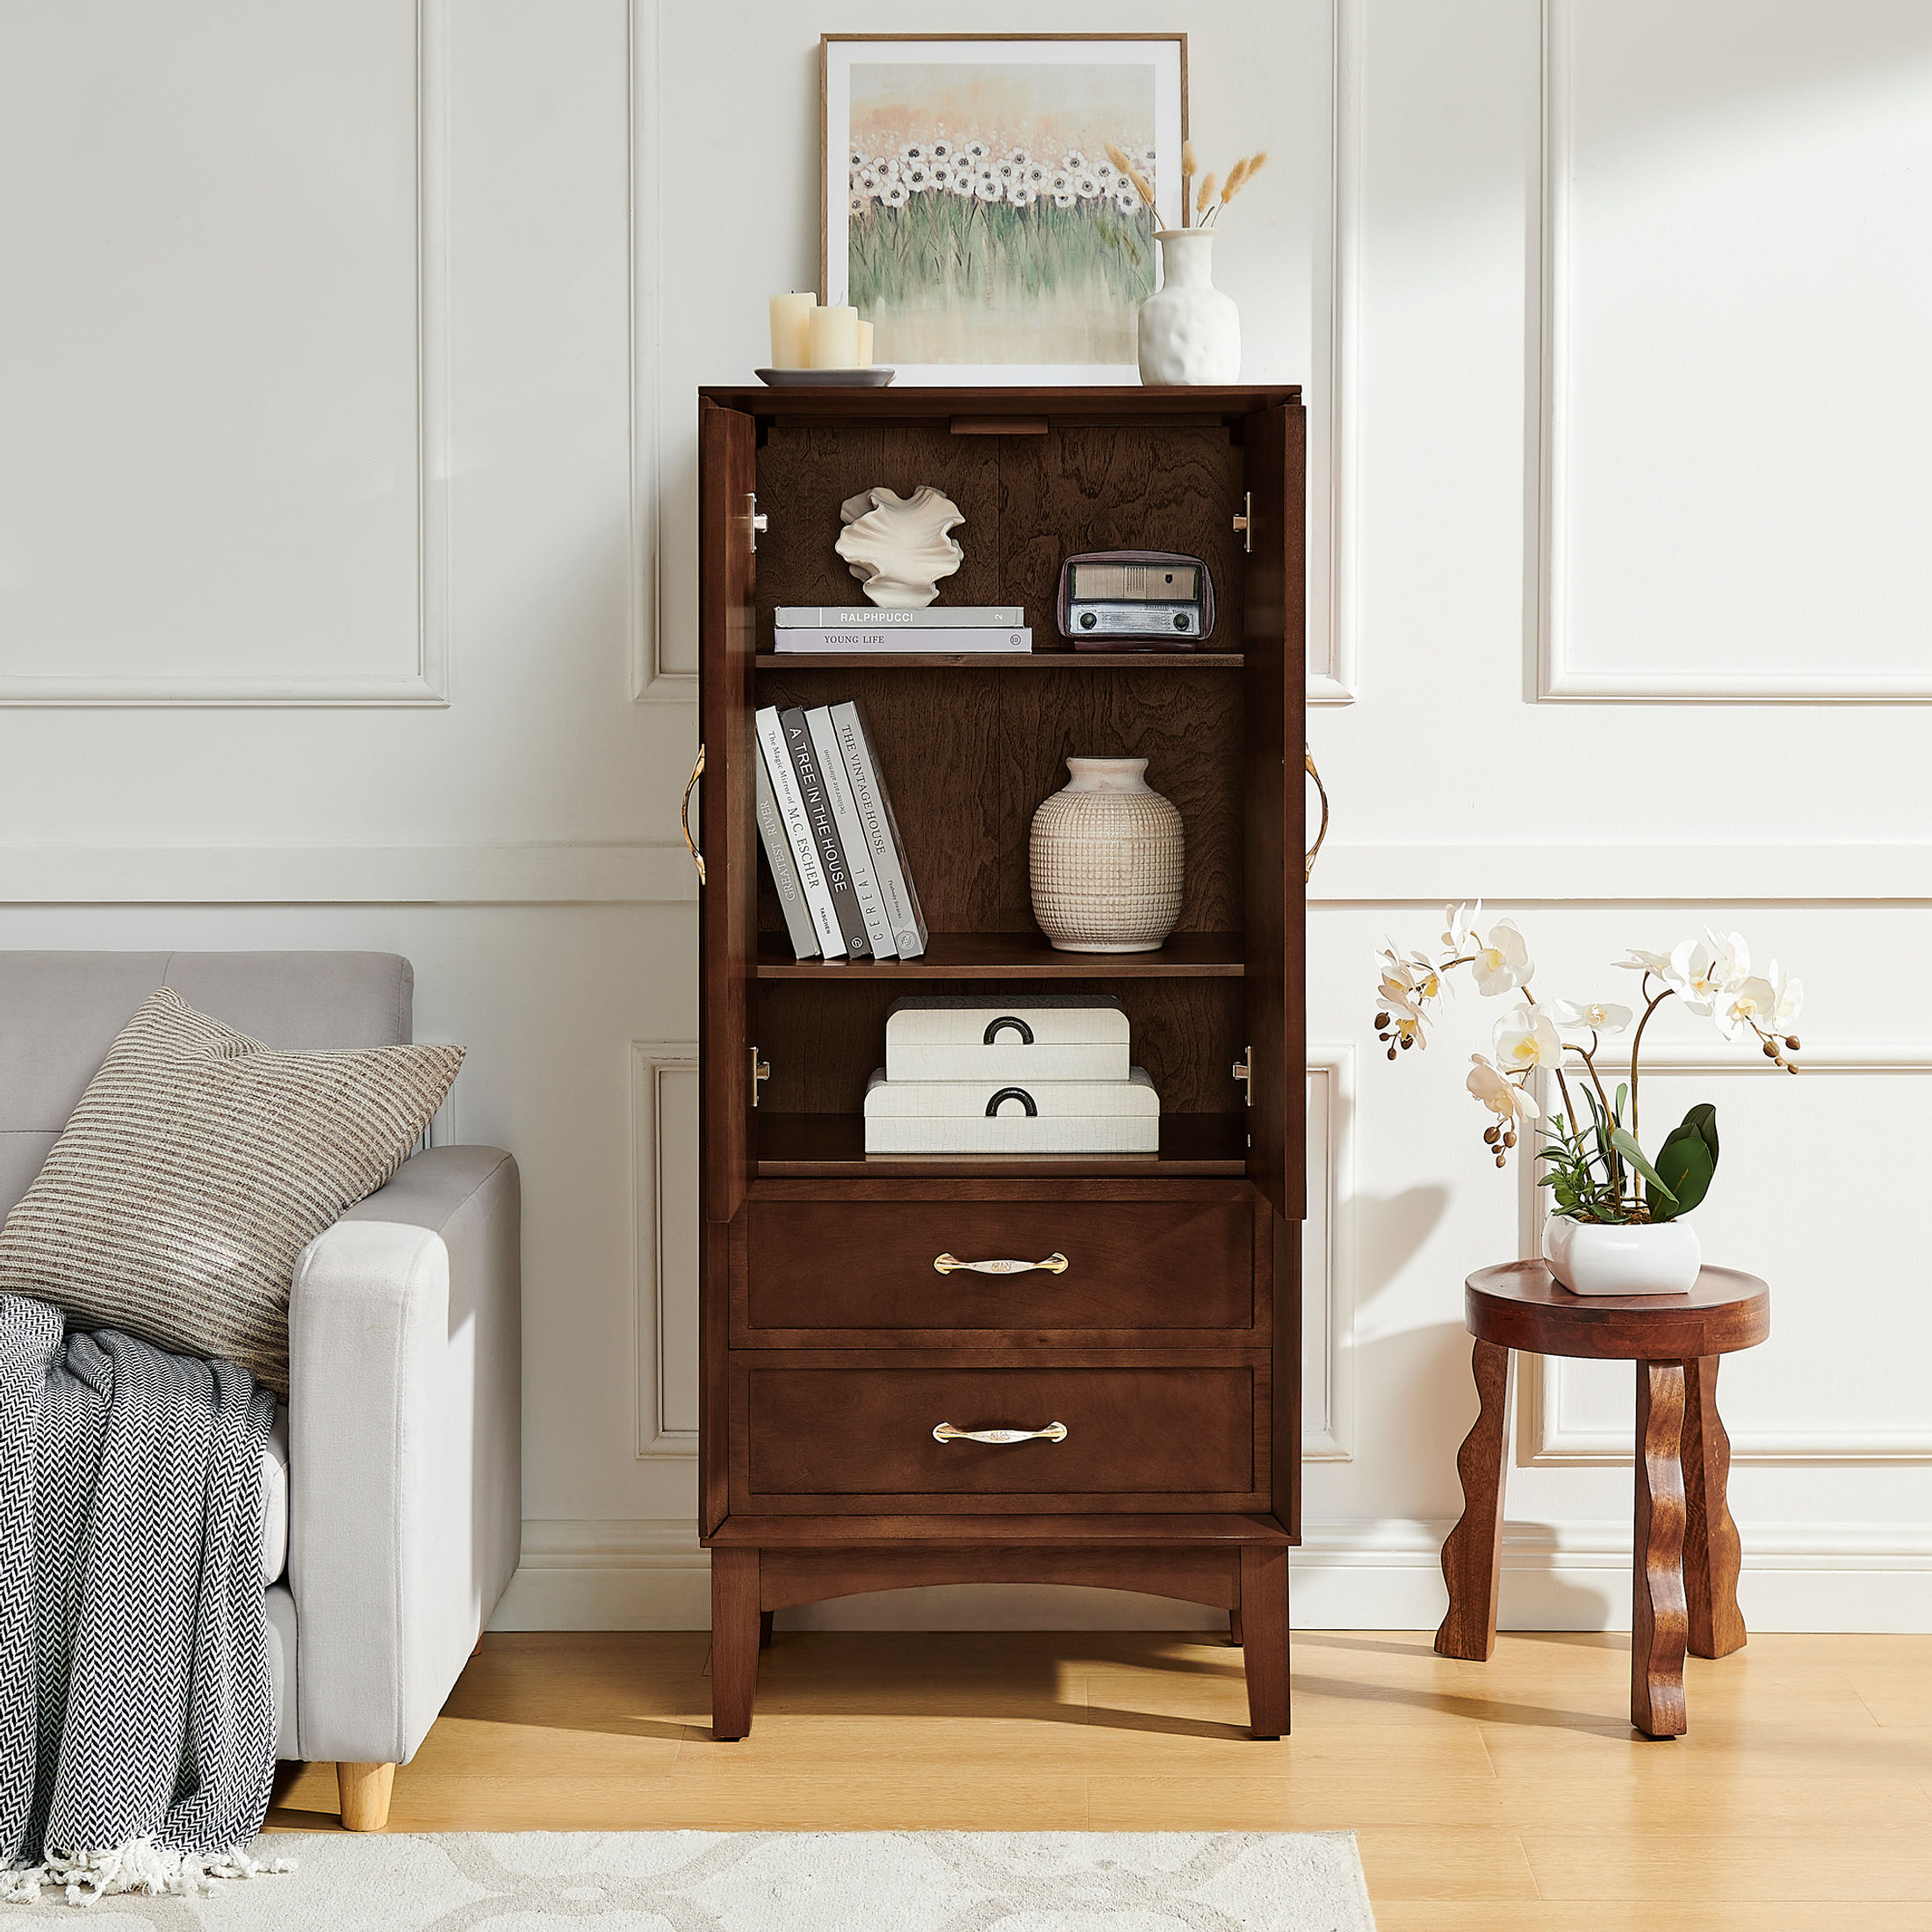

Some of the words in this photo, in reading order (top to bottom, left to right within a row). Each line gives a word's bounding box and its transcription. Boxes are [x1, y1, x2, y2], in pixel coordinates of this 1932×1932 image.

[840, 612, 913, 623] RALPHPUCCI
[825, 635, 859, 644] YOUNG
[862, 635, 885, 644] LIFE
[768, 730, 778, 746] The
[789, 728, 803, 739] A
[840, 724, 856, 752] THE
[771, 746, 785, 769] Magic
[794, 742, 816, 785] TREE
[823, 749, 837, 782] alienation
[778, 769, 792, 795] Mirror
[805, 786, 821, 804] IN
[786, 795, 795, 804] of
[833, 782, 847, 815] Deliberate
[759, 800, 777, 836] RIVER
[787, 806, 805, 836] M.C.
[811, 804, 831, 836] THE
[770, 841, 796, 902] GREATEST
[796, 837, 820, 889] ESCHER
[821, 837, 847, 893] HOUSE
[854, 868, 884, 941] CEREAL
[818, 906, 831, 934] TASCHEN
